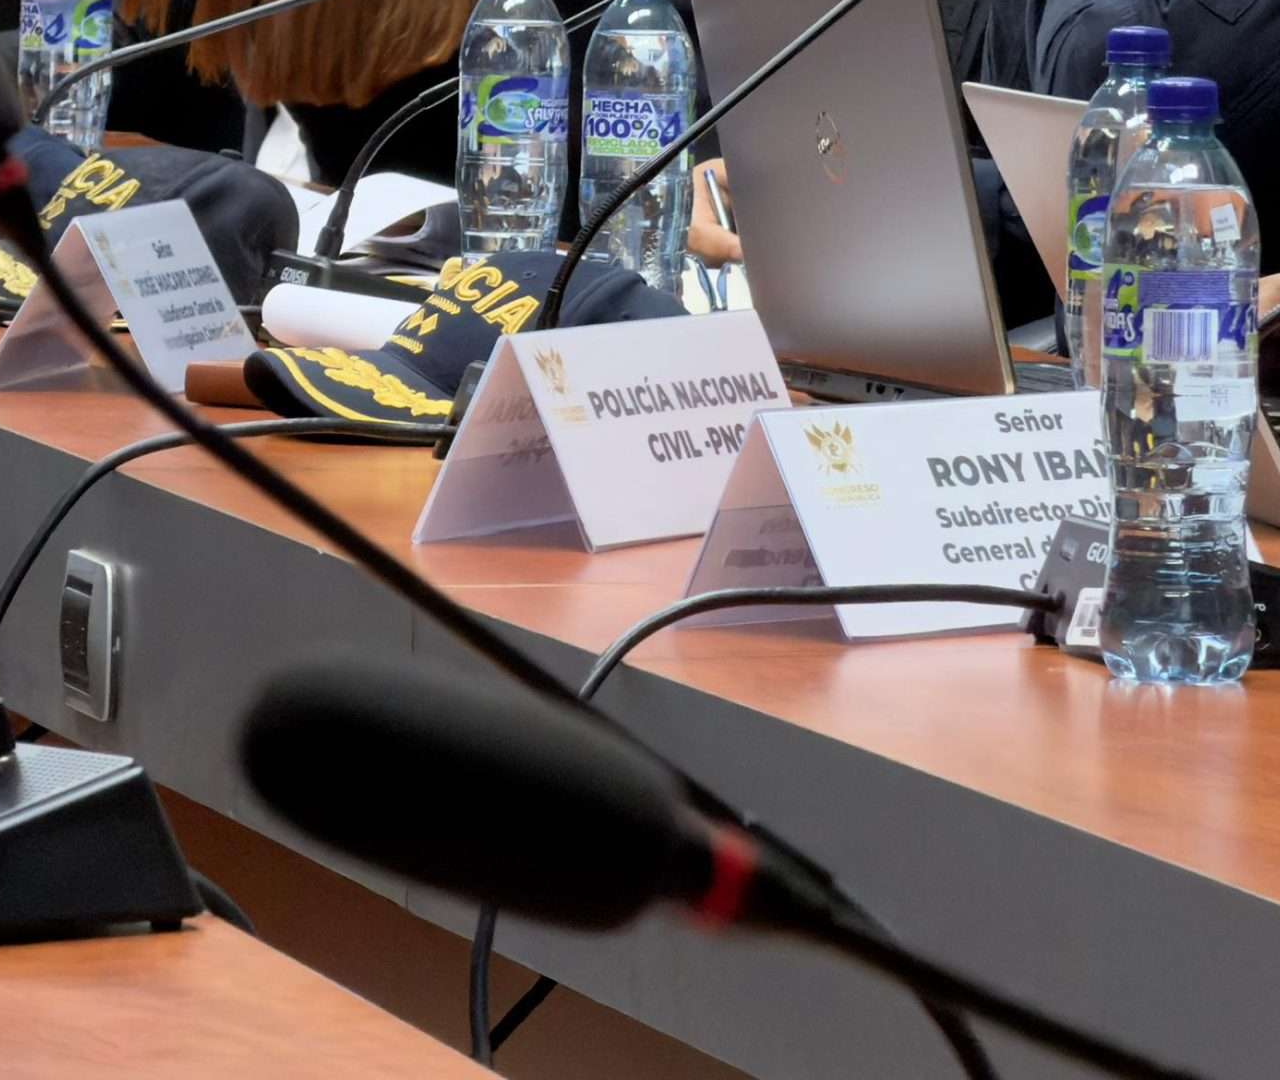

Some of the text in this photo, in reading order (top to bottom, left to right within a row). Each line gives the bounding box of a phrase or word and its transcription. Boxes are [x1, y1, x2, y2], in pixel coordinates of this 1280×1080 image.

[592, 100, 653, 114] HECHA
[587, 117, 660, 139] 100%
[587, 376, 675, 420] POLICÍA
[671, 372, 778, 411] NACIONAL
[993, 408, 1064, 434] Señor
[647, 426, 702, 463] CIVIL
[926, 448, 1026, 488] RONY
[935, 498, 1074, 530] Subdirector
[942, 536, 1036, 565] General
